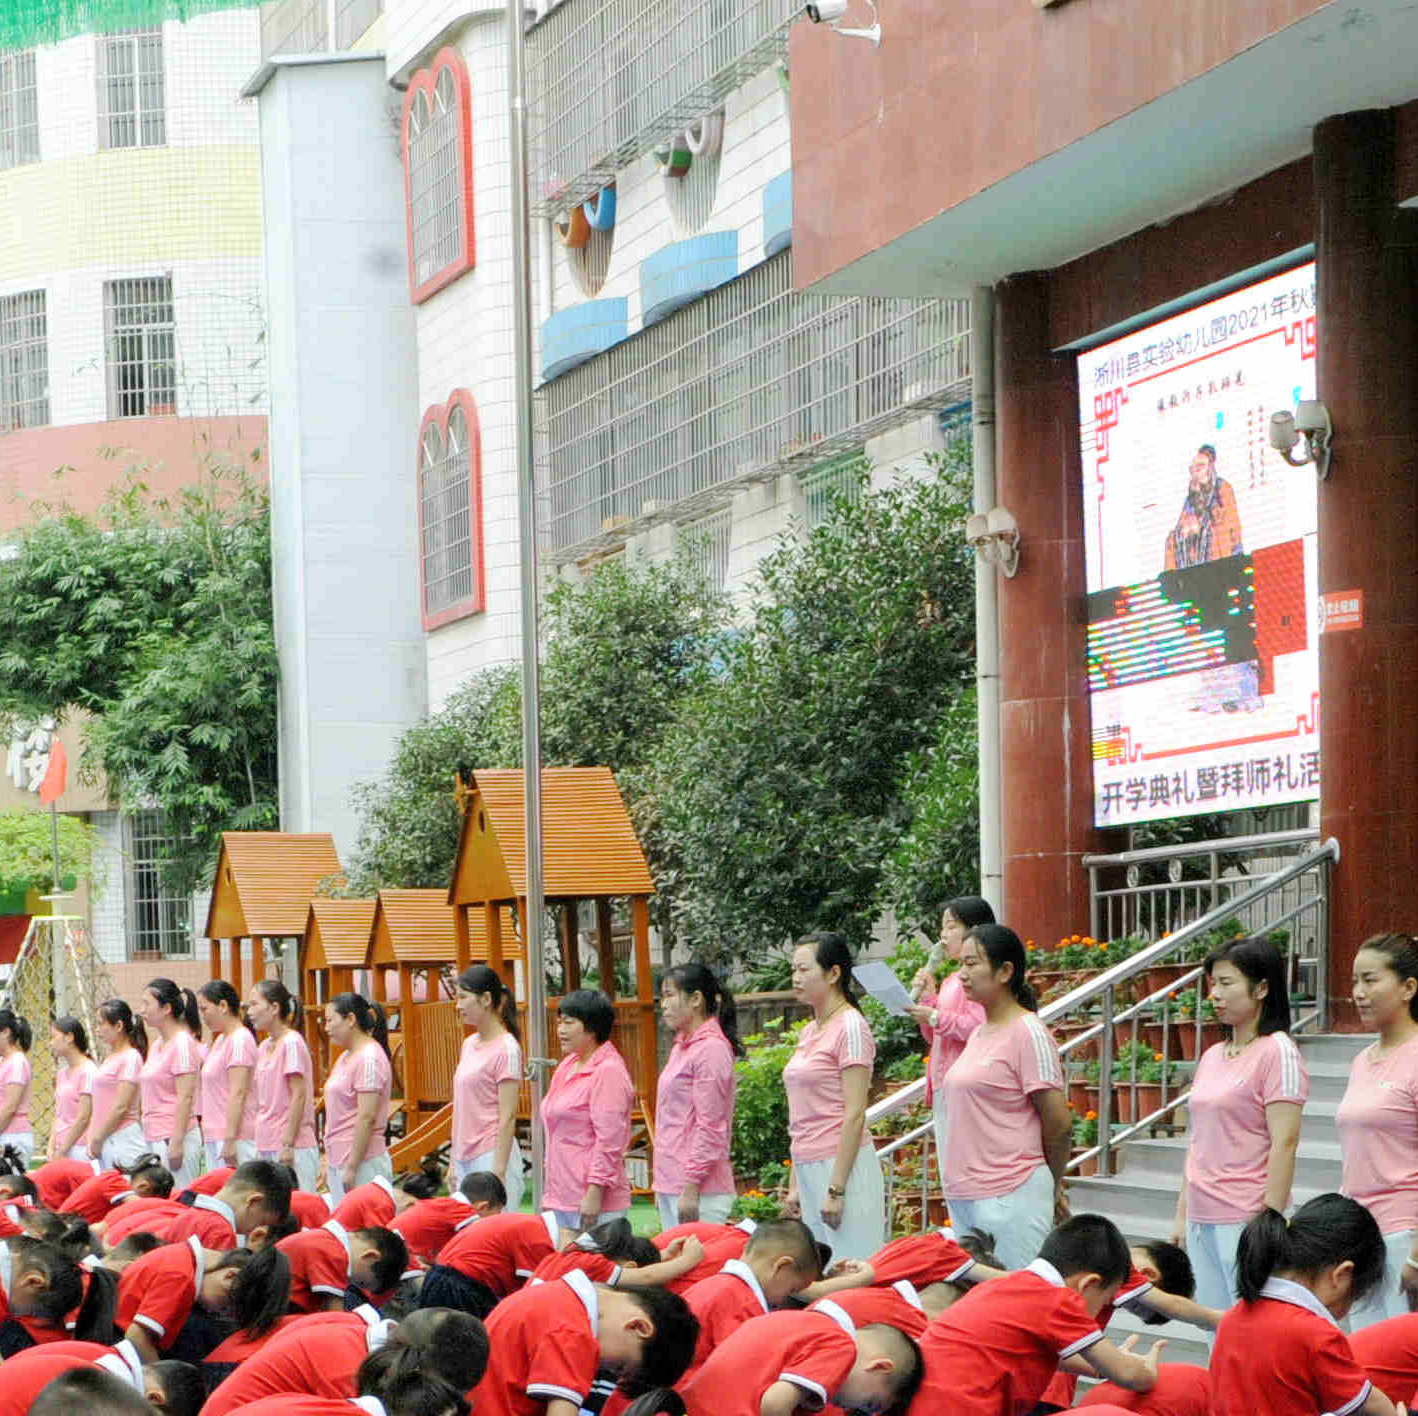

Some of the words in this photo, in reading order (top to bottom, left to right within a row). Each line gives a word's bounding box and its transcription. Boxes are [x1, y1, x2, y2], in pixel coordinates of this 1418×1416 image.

[1101, 751, 1320, 815] 开学典礼暨拜师礼活
